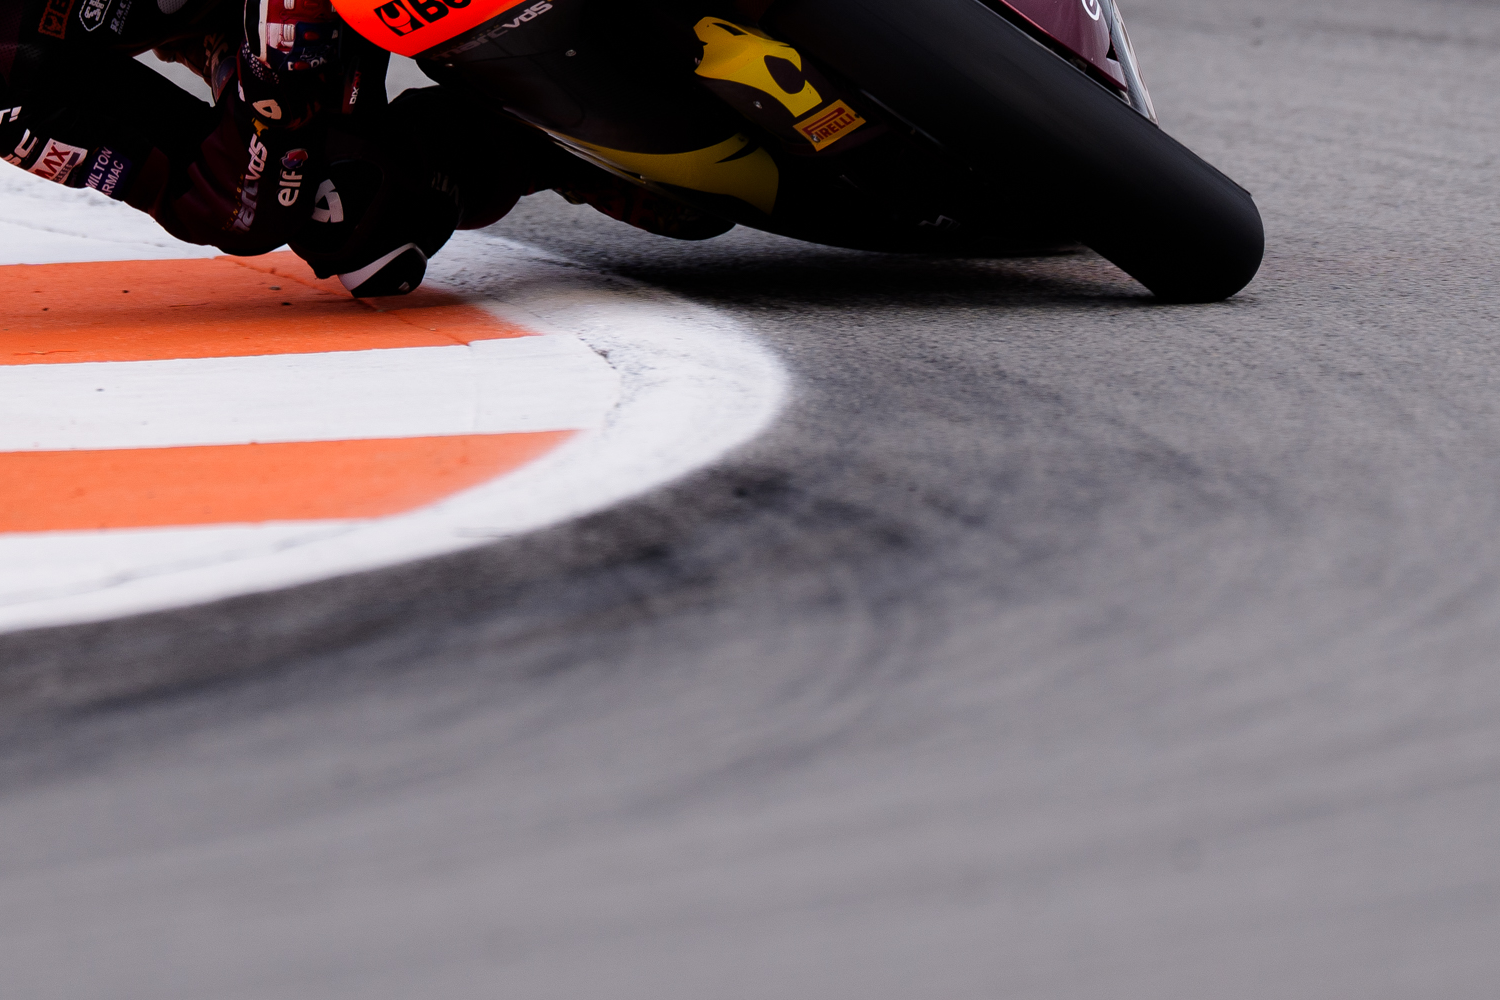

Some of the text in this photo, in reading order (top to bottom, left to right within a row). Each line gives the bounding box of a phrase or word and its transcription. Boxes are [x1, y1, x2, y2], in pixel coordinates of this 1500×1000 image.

[801, 109, 853, 143] PIRELLI
[85, 147, 112, 189] MILTON
[102, 160, 124, 196] ARMAC
[278, 170, 305, 207] elf
